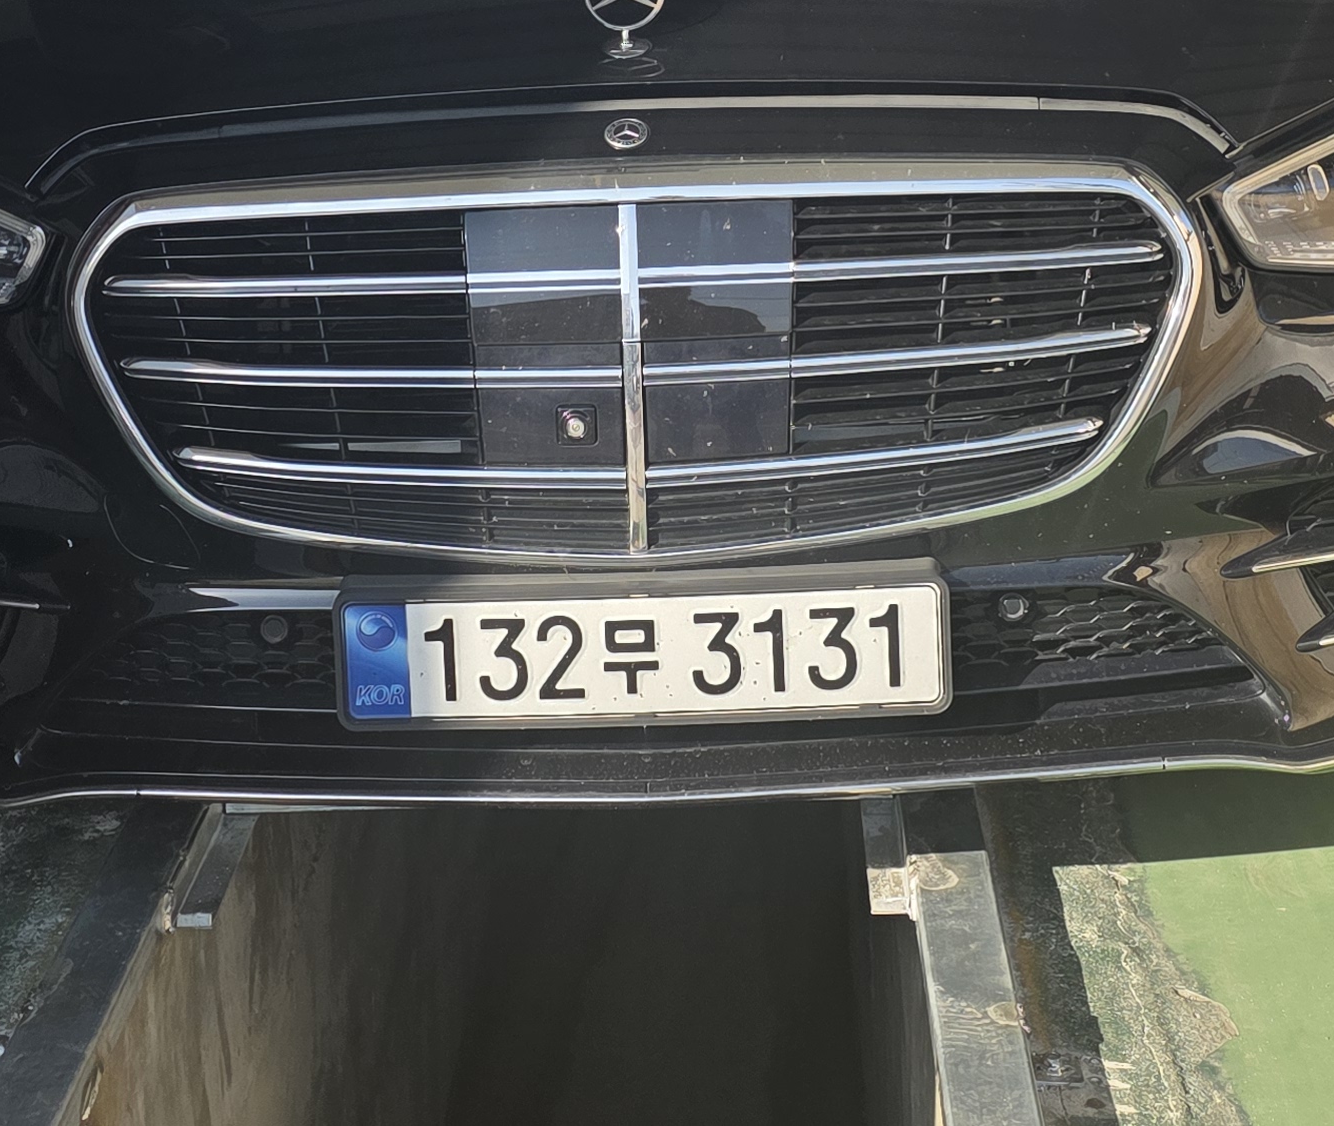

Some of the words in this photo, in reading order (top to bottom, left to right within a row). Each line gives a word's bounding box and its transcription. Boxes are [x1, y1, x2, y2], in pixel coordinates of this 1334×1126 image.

[422, 613, 659, 703] 132무
[690, 602, 904, 696] 3131
[355, 683, 406, 706] KOR
